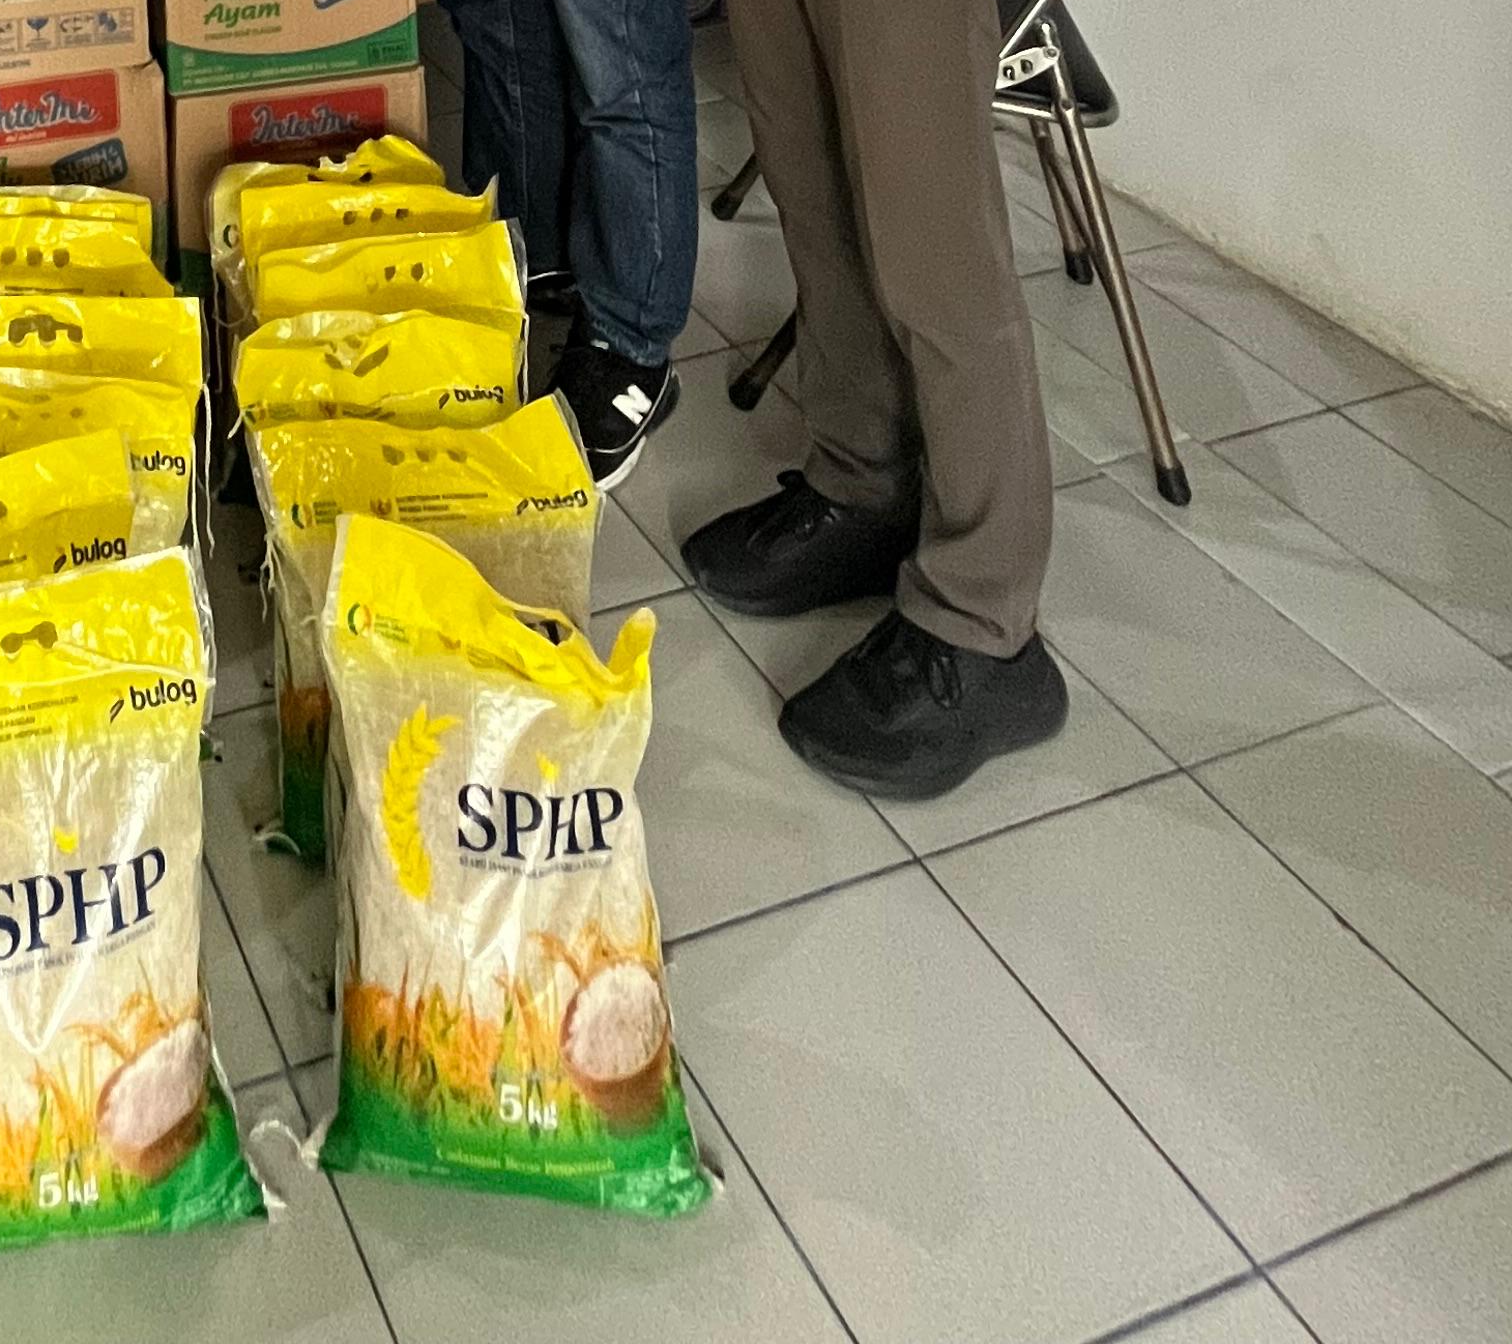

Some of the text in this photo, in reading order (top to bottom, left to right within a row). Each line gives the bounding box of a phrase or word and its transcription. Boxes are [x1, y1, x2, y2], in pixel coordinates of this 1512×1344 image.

[203, 2, 281, 28] Ayam
[71, 537, 127, 566] bulog
[129, 677, 197, 712] bulog
[458, 783, 624, 860] SPHP
[499, 1083, 523, 1123] 5
[38, 1172, 62, 1208] 5
